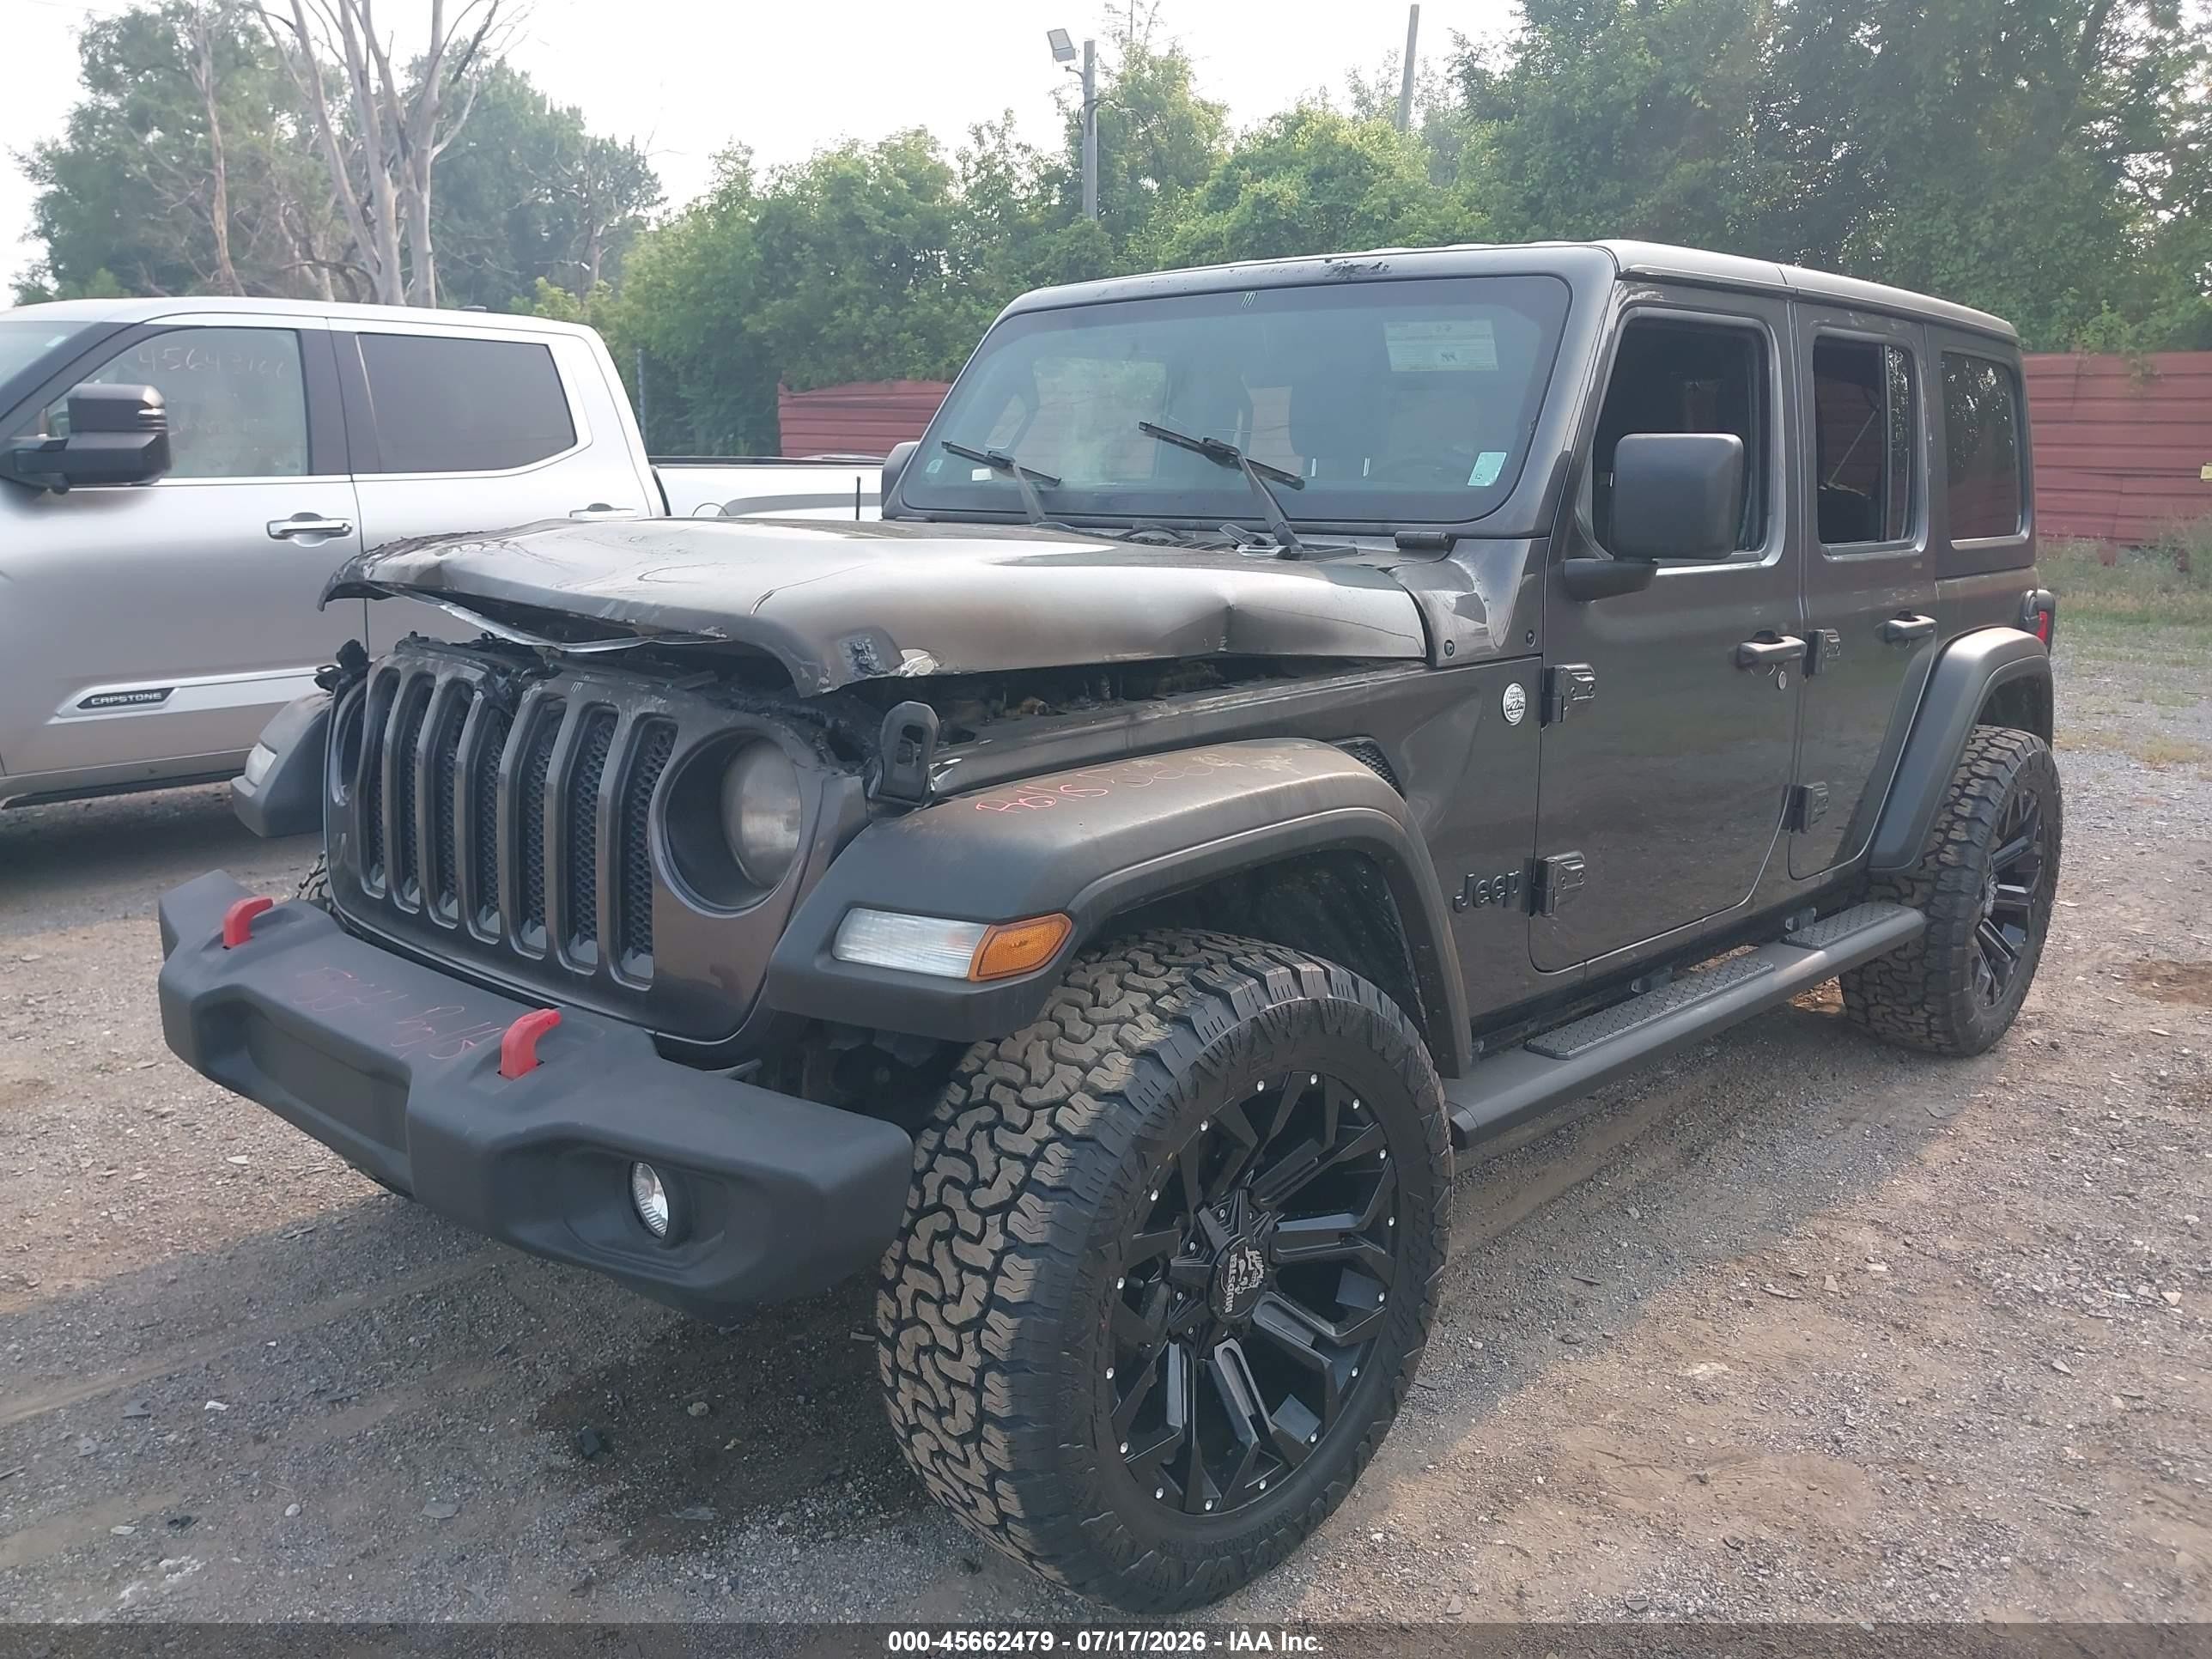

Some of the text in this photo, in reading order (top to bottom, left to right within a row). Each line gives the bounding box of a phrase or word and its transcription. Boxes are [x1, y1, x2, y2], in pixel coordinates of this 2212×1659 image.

[91, 692, 161, 705] CAPSTONE
[1452, 869, 1520, 913] Jeep
[1224, 1252, 1238, 1314] MUDSTER
